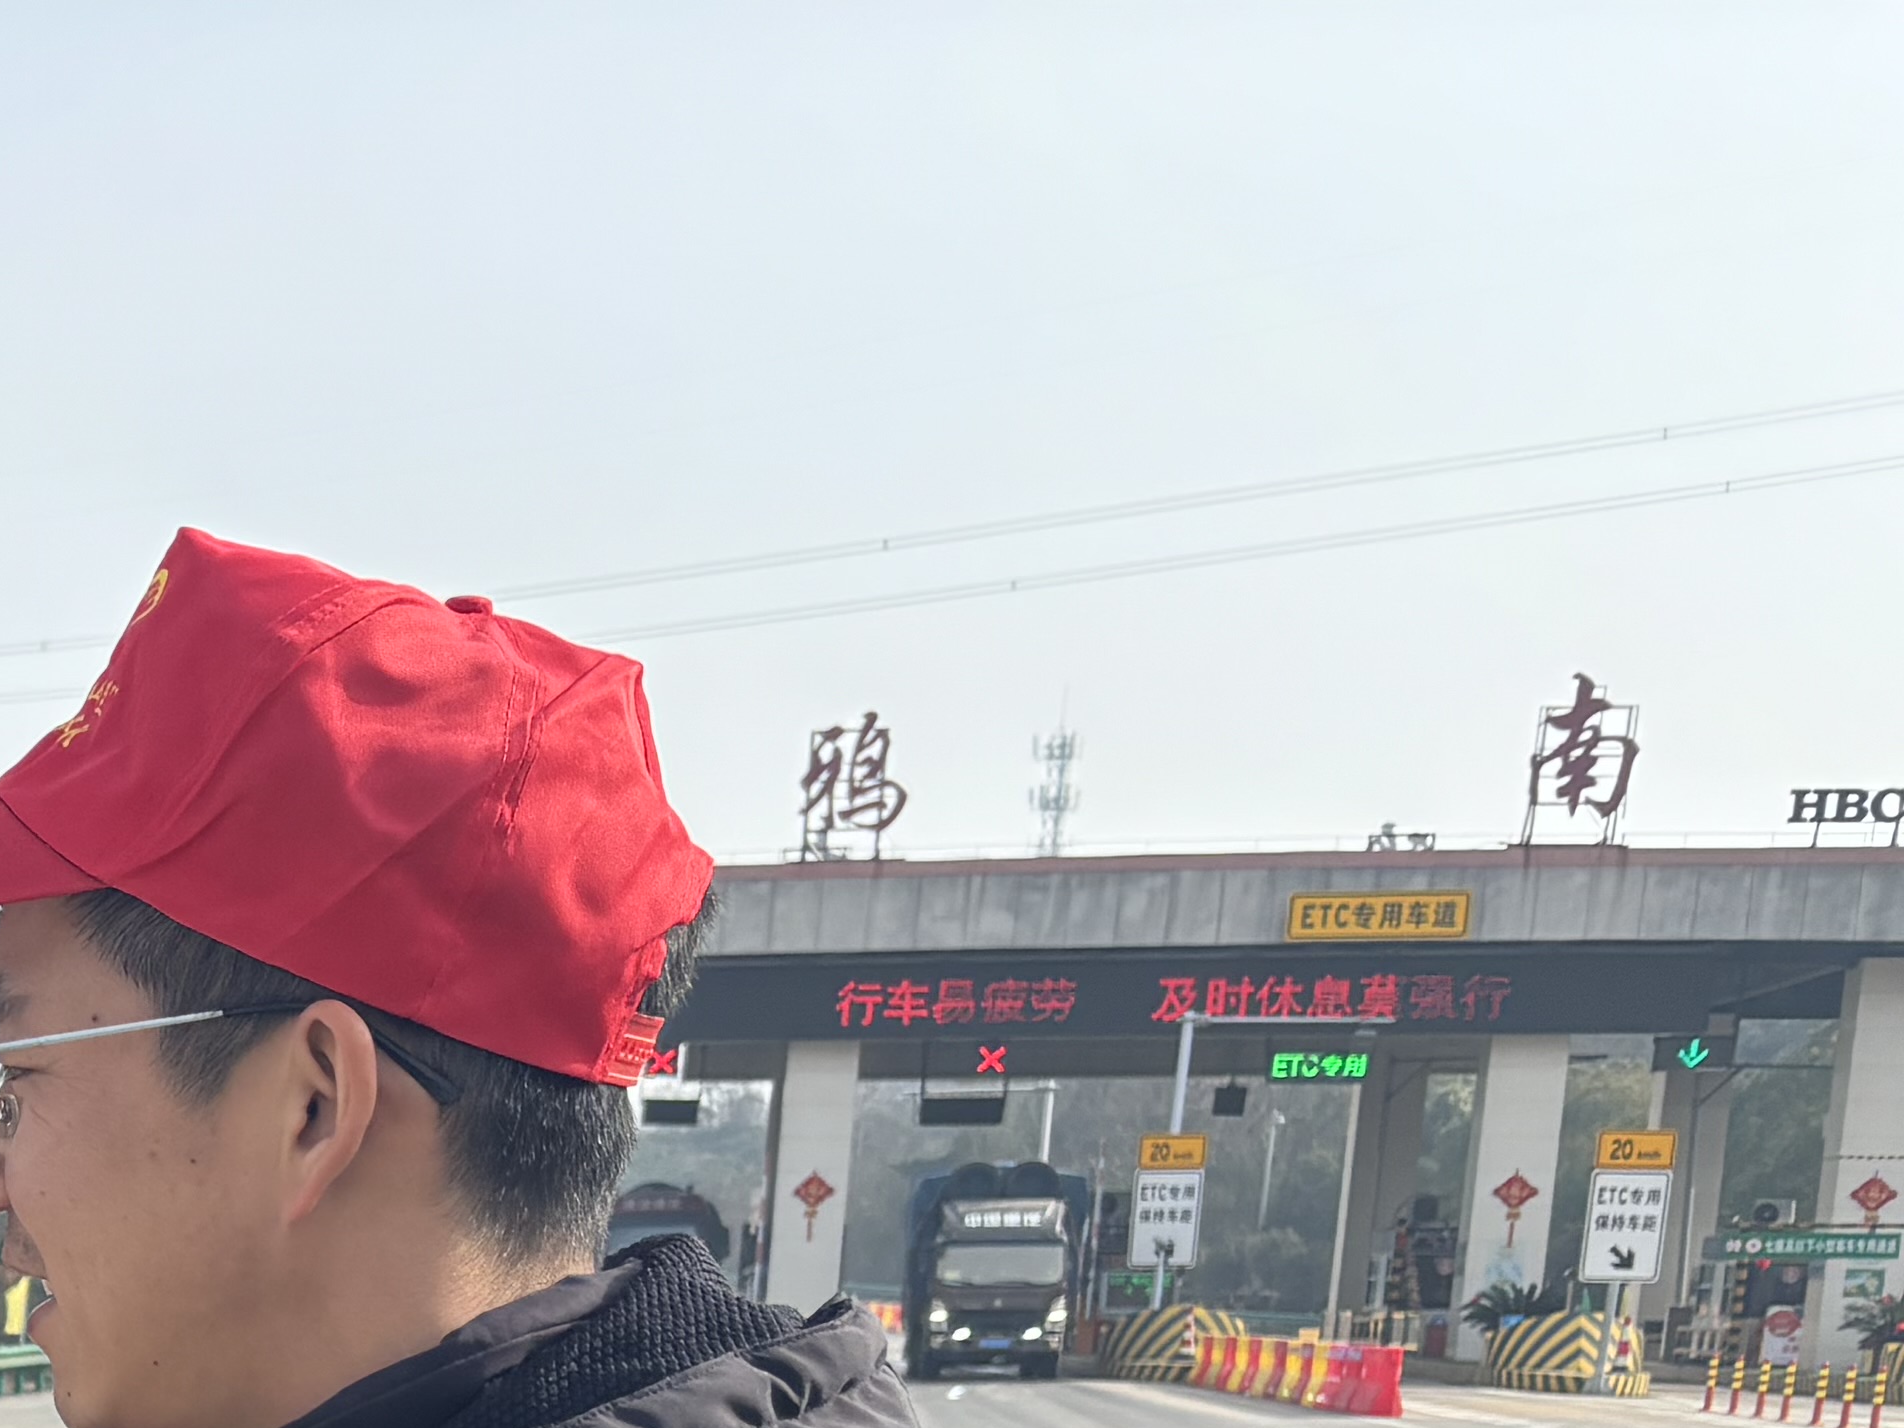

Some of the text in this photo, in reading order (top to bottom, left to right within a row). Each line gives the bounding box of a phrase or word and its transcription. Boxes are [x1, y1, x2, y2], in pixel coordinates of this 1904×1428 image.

[1529, 672, 1640, 819] 南
[1300, 901, 1458, 930] ETC专用车道
[836, 973, 1512, 1027] 行车易疲劳 及时休息莫强行
[1271, 1053, 1369, 1079] ETC专用
[1610, 1138, 1634, 1161] 20
[1596, 1186, 1662, 1206] ETC专用
[1594, 1214, 1657, 1232] 保持车距
